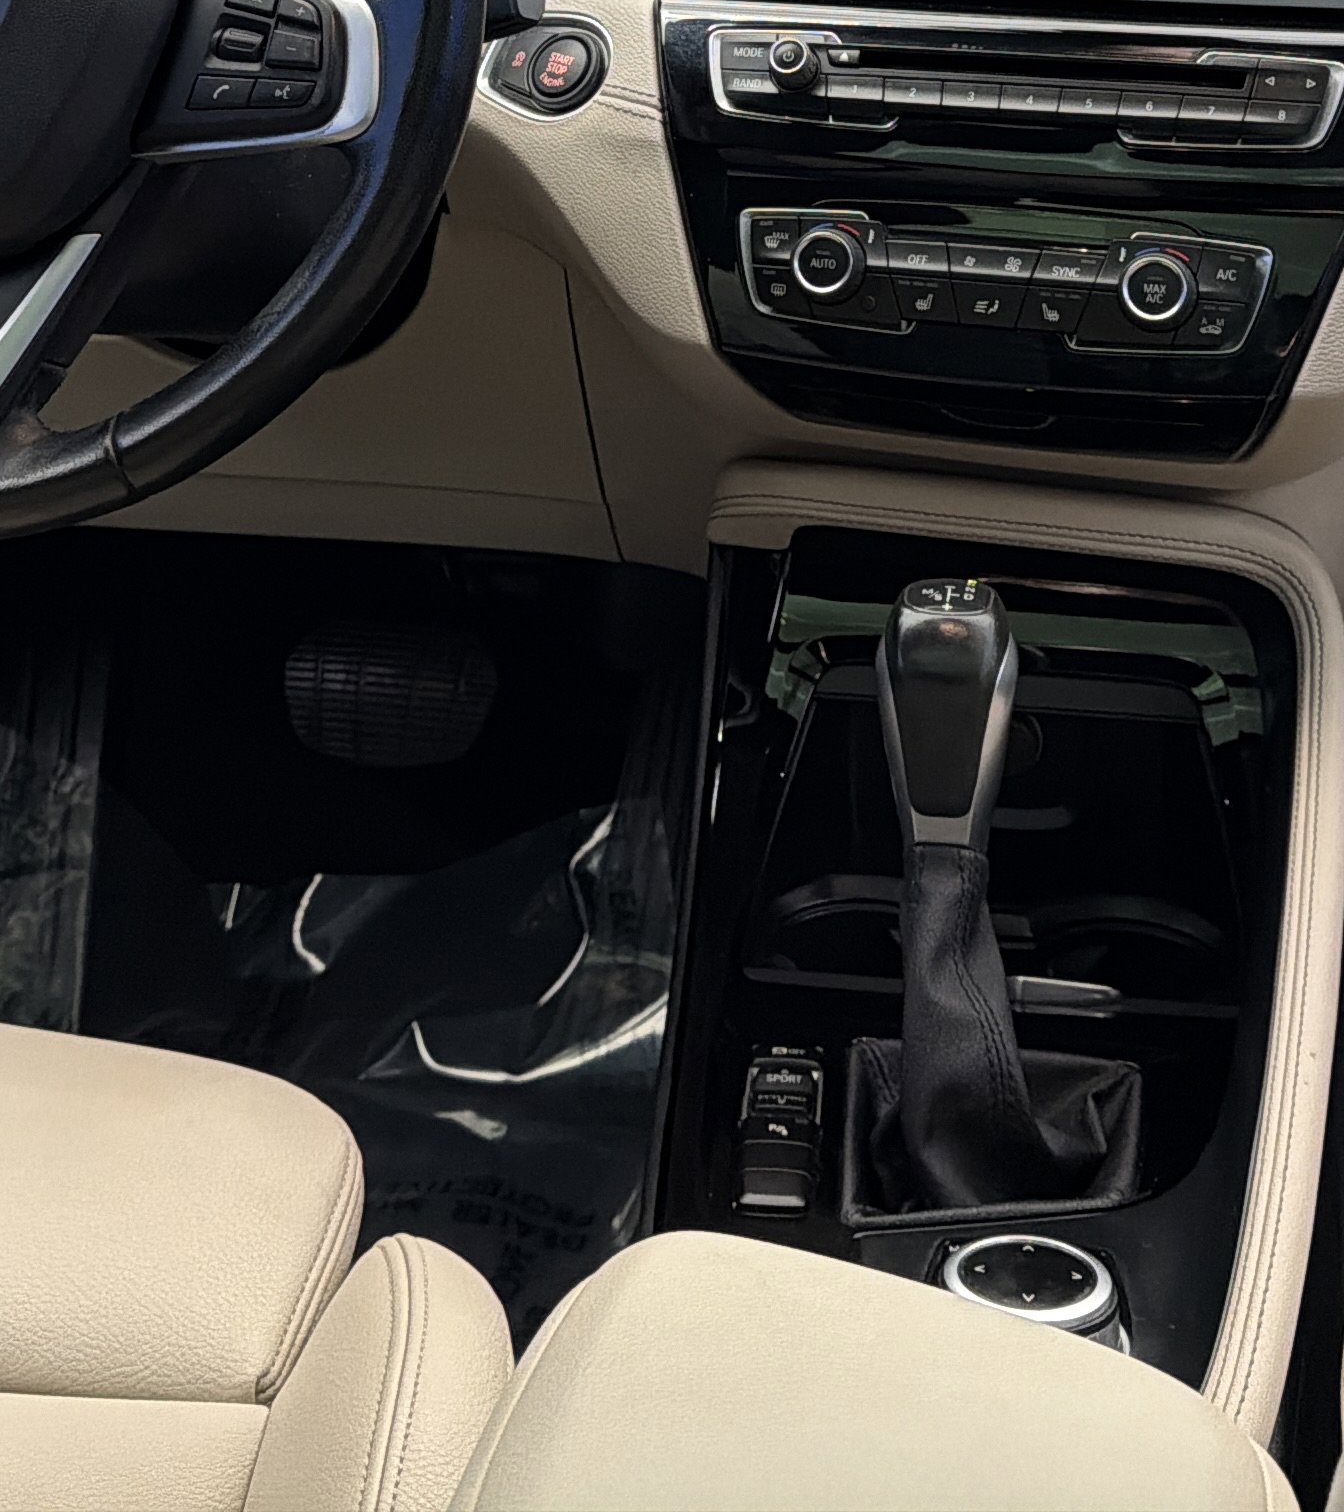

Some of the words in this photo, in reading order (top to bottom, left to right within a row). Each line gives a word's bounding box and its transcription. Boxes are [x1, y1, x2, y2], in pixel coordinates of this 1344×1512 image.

[733, 46, 765, 58] MODE
[549, 51, 576, 66] START
[546, 61, 568, 75] STOP
[539, 71, 565, 87] ENGINE
[732, 78, 762, 89] BAND
[908, 87, 917, 98] 2
[967, 91, 975, 102] 3
[1026, 95, 1034, 105] 4
[1085, 98, 1093, 108] 5
[1145, 101, 1154, 111] 6
[1207, 106, 1216, 116] 7
[1277, 110, 1286, 121] 8
[809, 258, 837, 270] AUTO
[907, 254, 929, 266] OFF
[1051, 265, 1081, 278] SYNC
[1215, 268, 1238, 282] A/C
[1143, 283, 1167, 295] MAX
[1145, 293, 1164, 304] A/C
[766, 1073, 803, 1085] SPORT
